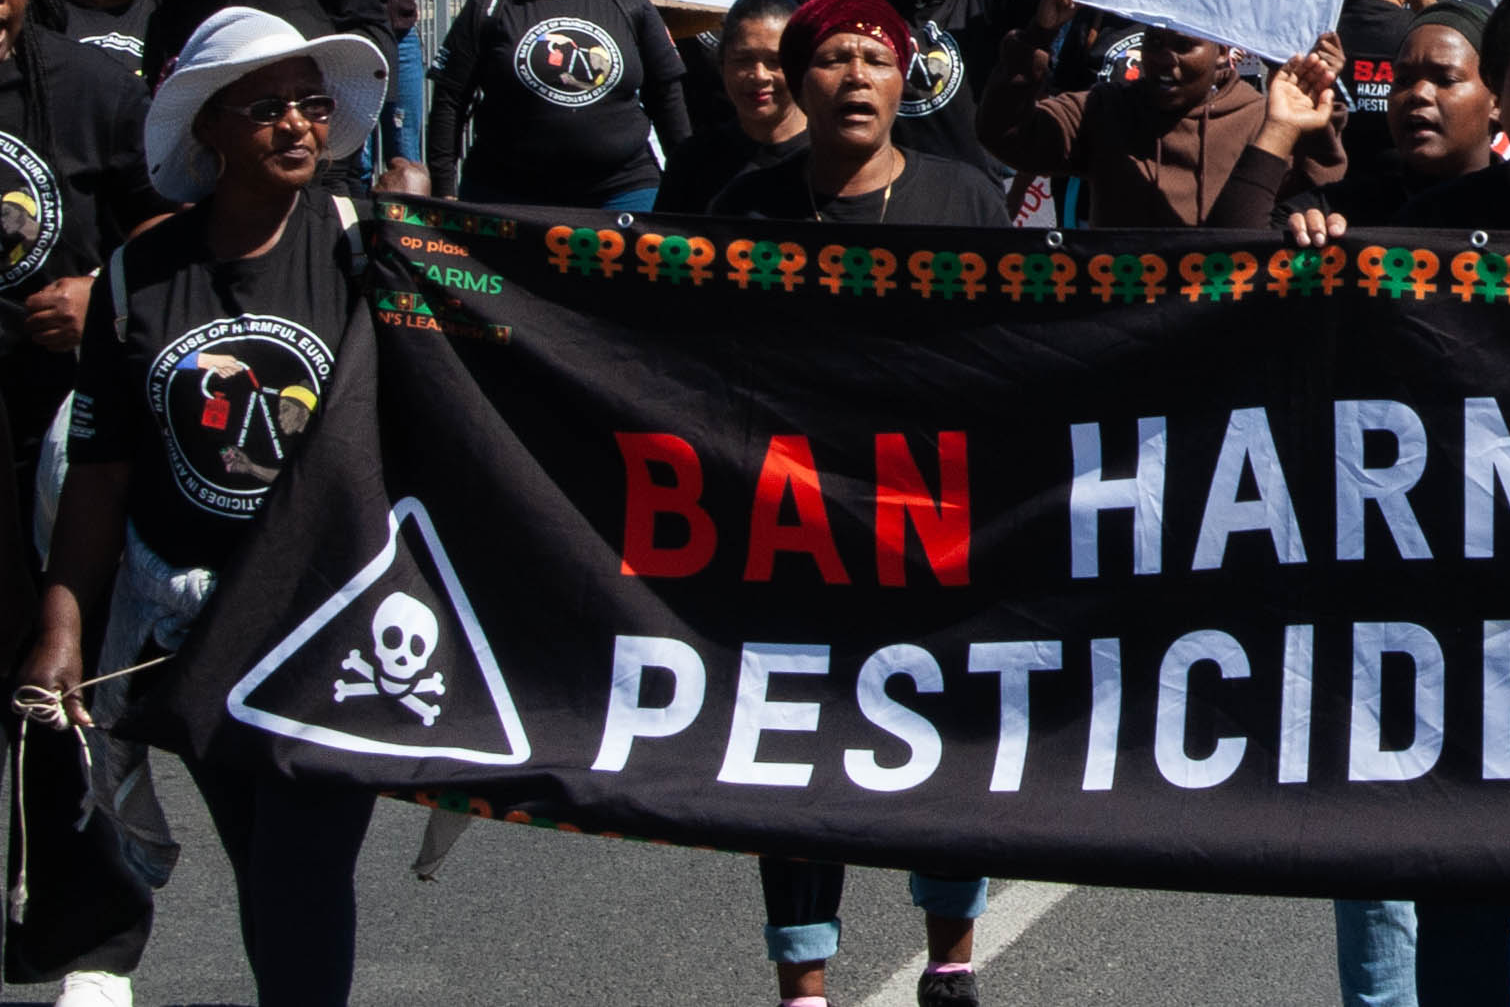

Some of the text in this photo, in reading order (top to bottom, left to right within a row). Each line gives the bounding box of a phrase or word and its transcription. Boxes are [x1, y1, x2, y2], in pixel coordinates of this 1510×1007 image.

[156, 355, 180, 380] THE
[177, 333, 206, 354] USE
[208, 324, 229, 339] OF
[231, 321, 298, 343] HARMFUL
[406, 315, 442, 332] LEA
[614, 431, 971, 587] BAN
